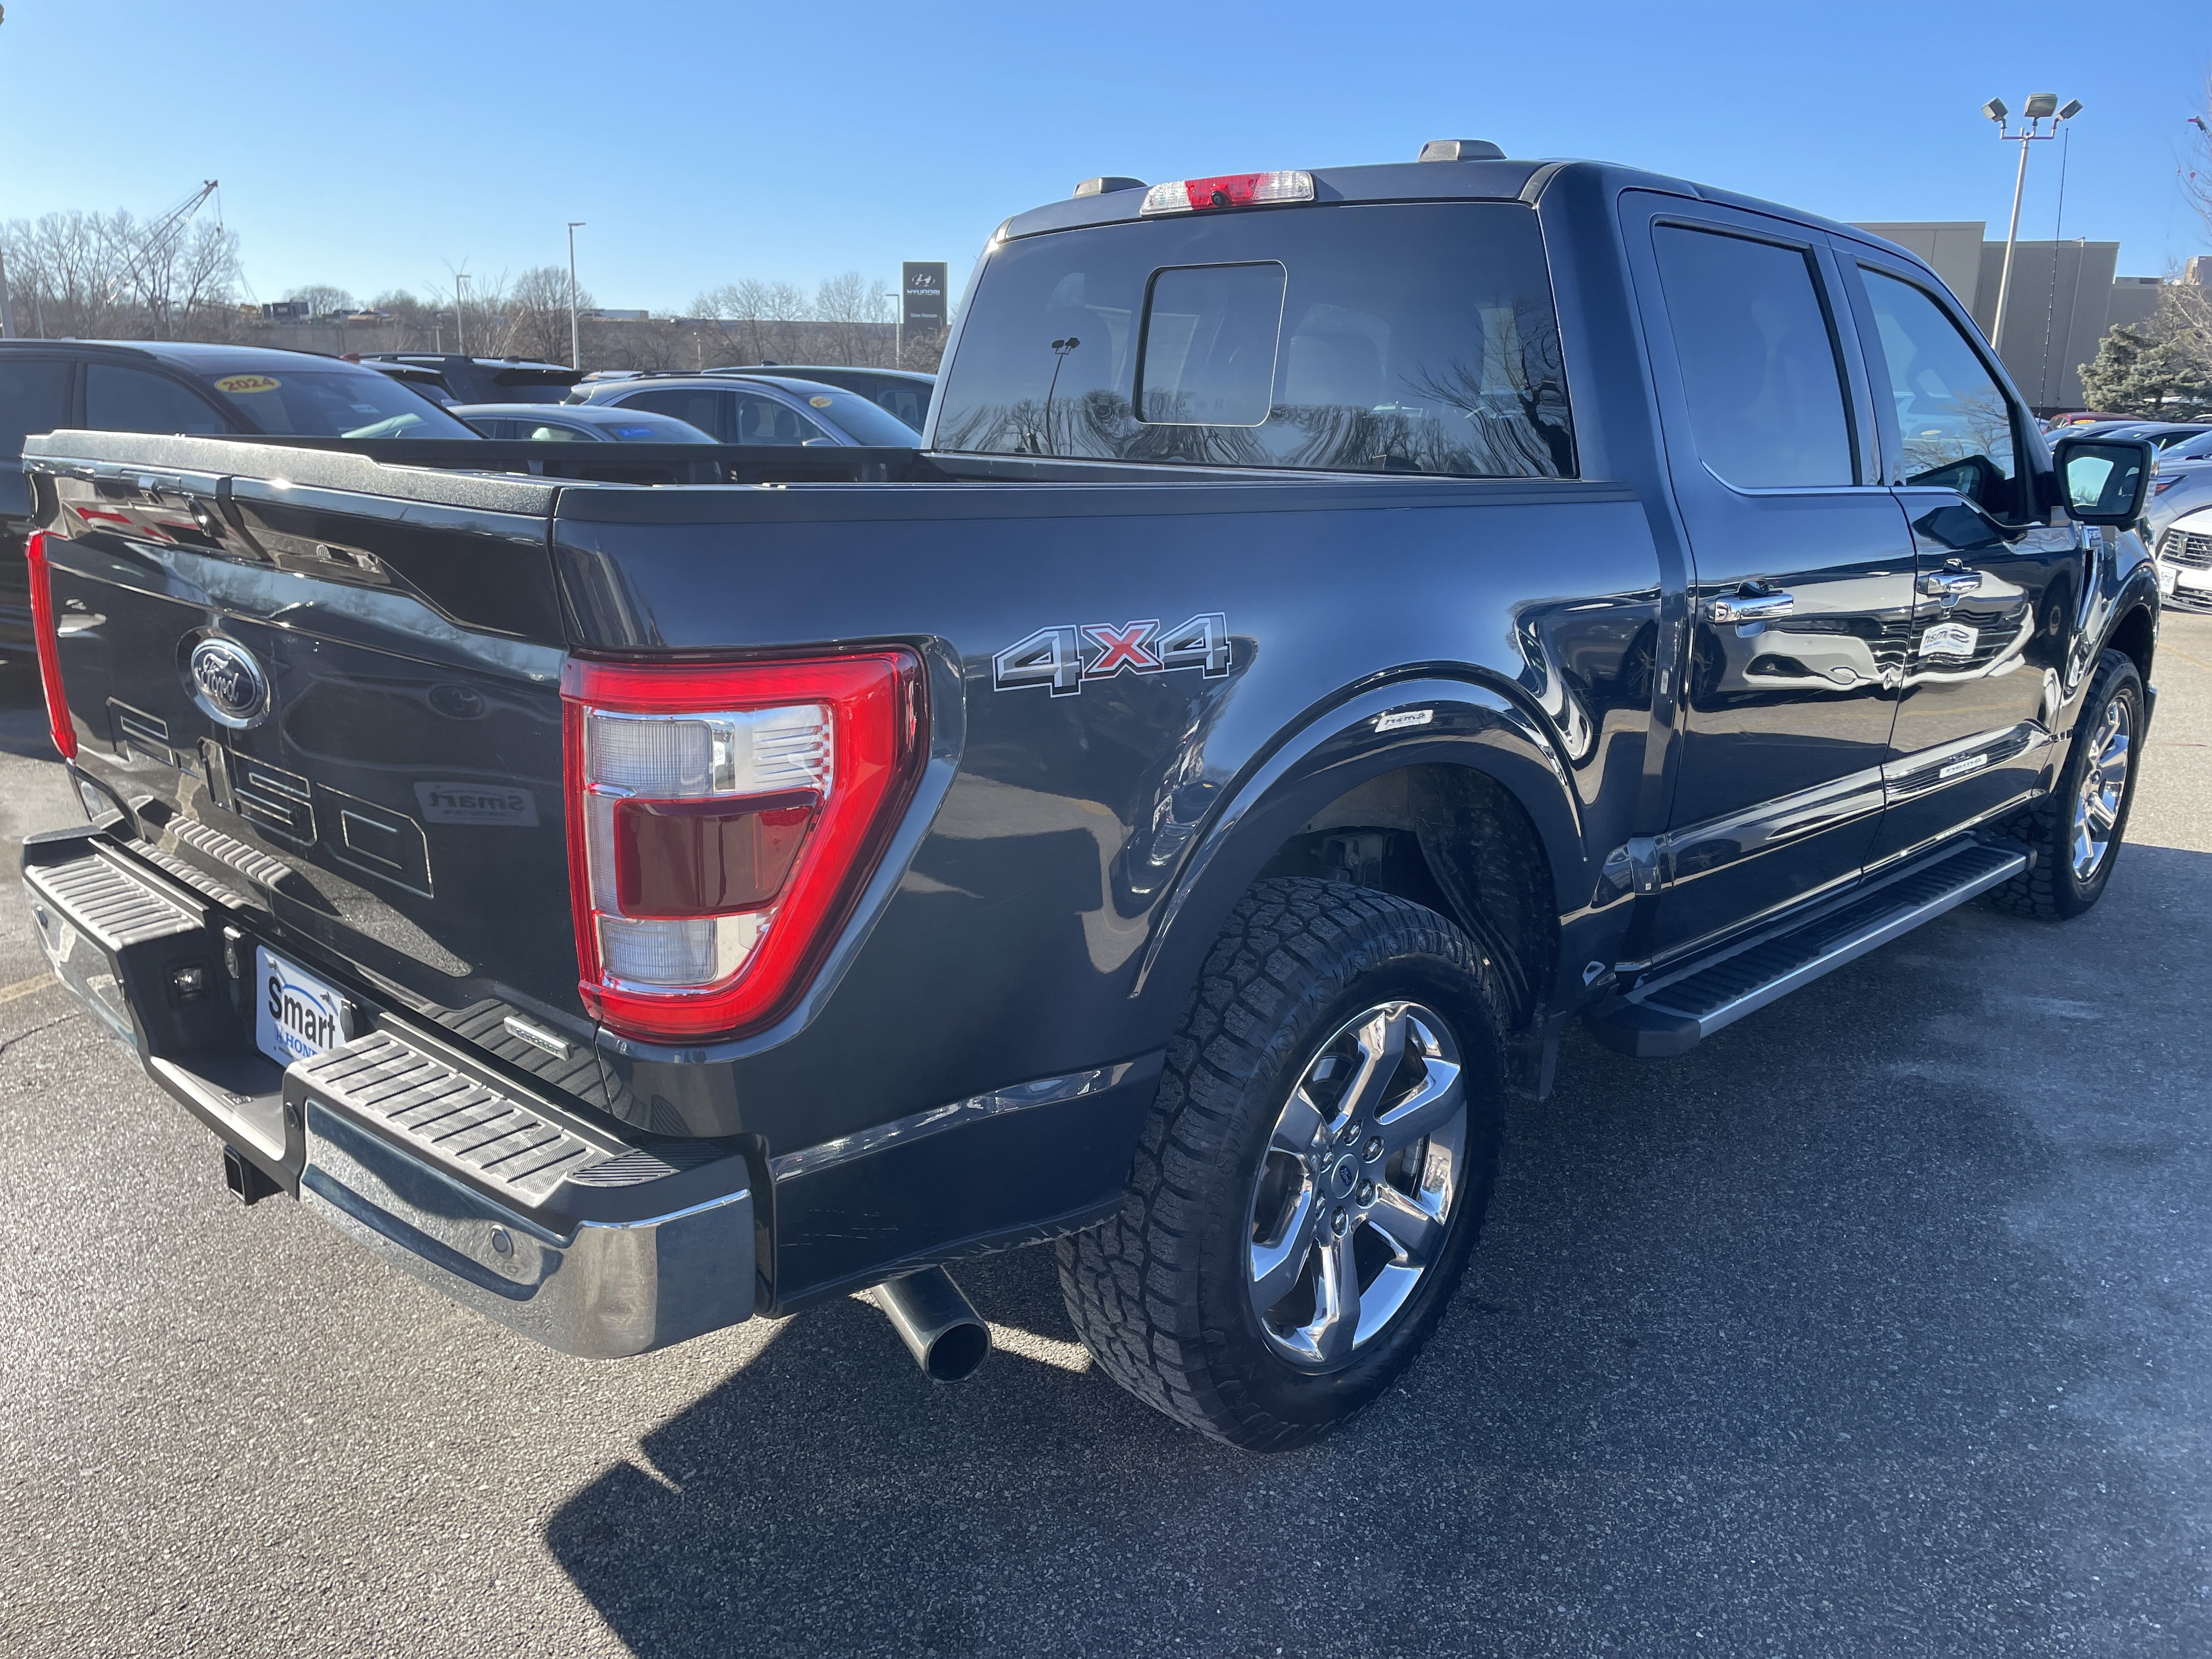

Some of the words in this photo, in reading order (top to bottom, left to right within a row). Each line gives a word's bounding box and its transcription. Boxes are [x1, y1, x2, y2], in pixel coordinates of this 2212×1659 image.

[222, 376, 275, 391] 2024
[200, 652, 240, 703] Ford
[106, 696, 434, 899] F-150
[268, 976, 335, 1049] Smart
[285, 1031, 318, 1057] HON
